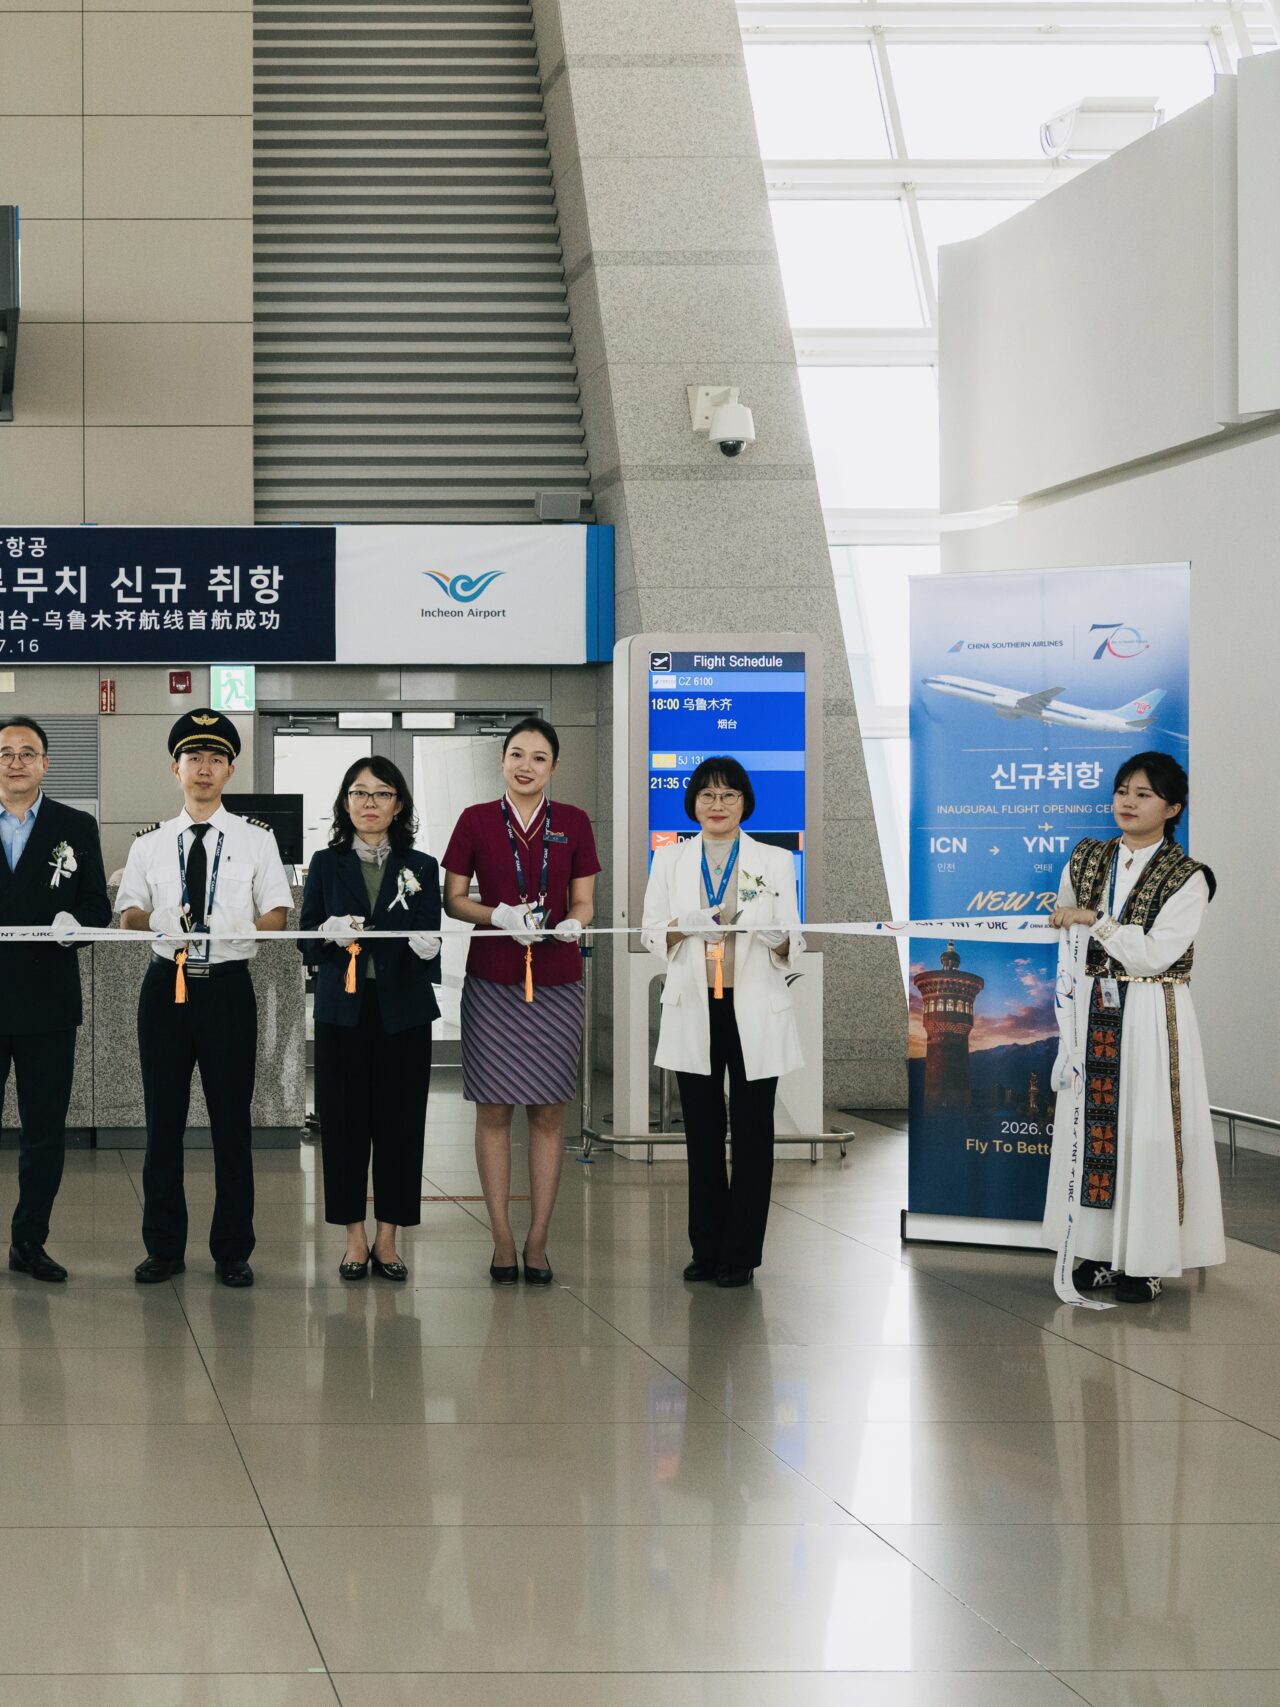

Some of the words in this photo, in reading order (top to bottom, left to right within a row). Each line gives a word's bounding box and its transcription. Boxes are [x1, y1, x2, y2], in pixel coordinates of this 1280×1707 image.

[110, 565, 188, 604] 신규
[207, 565, 285, 604] 취항
[421, 608, 464, 618] Incheon
[467, 608, 507, 621] Airport
[967, 641, 990, 650] CHINA
[991, 640, 1031, 649] SOUTHERN
[1032, 640, 1064, 649] AIRLINES
[693, 655, 726, 670] Flight
[728, 655, 783, 667] Schedule
[678, 676, 692, 686] CZ
[693, 676, 714, 686] 6100
[651, 698, 680, 711] 18:00
[682, 697, 733, 712] 乌鲁木齐
[717, 718, 738, 730] 烟台
[678, 756, 688, 765] 5J
[650, 777, 680, 789] 21:35
[990, 762, 1104, 791] 신규취항
[937, 804, 999, 815] INAUGURAL
[1001, 804, 1040, 815] FLIGHT
[1043, 804, 1093, 814] OPENING
[929, 836, 968, 854] ICN
[1023, 836, 1070, 853] YNT
[966, 890, 1035, 912] NEW
[987, 921, 1008, 931] URC
[1000, 1121, 1042, 1135] 2026.
[966, 1138, 989, 1155] Fly
[992, 1139, 1013, 1153] To
[1016, 1141, 1053, 1155] Bett
